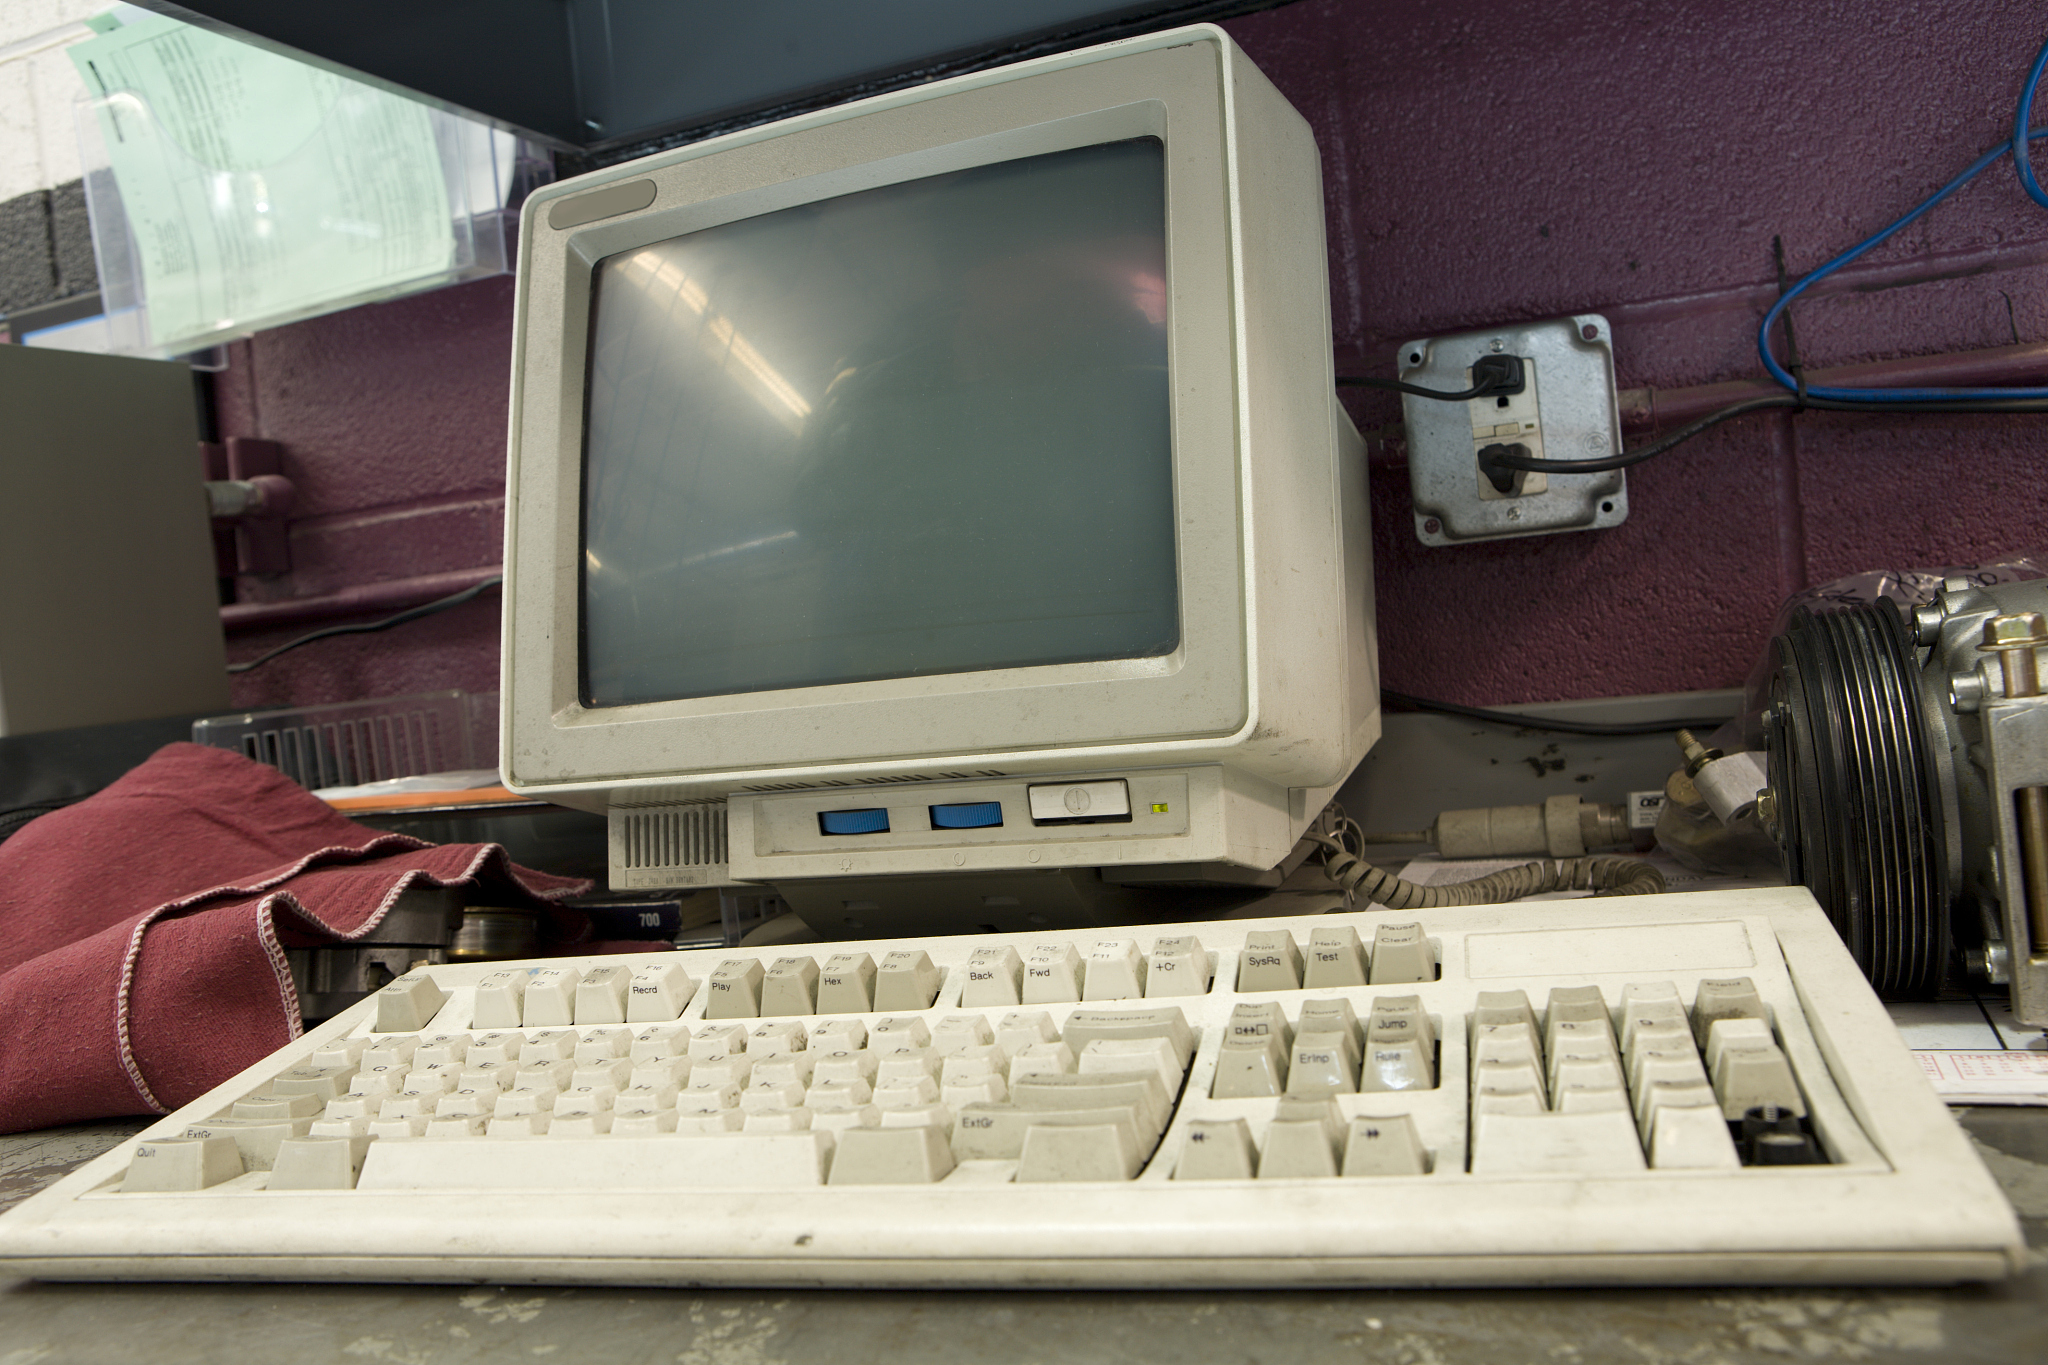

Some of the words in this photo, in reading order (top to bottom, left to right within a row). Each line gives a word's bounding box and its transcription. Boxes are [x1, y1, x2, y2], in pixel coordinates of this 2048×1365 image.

[638, 913, 660, 927] 700
[1249, 956, 1281, 966] SysRq
[1316, 952, 1339, 962] Test
[1155, 963, 1176, 972] +Cr
[970, 971, 994, 981] Back
[1029, 968, 1051, 978] Fwd
[824, 977, 842, 986] Hex
[632, 986, 658, 995] Recrd
[712, 983, 731, 992] Play
[1378, 1019, 1408, 1030] Jump
[1374, 1051, 1401, 1061] Rule
[962, 1117, 994, 1129] ExtGr
[187, 1130, 212, 1139] ExtGr
[137, 1147, 157, 1157] Quit
